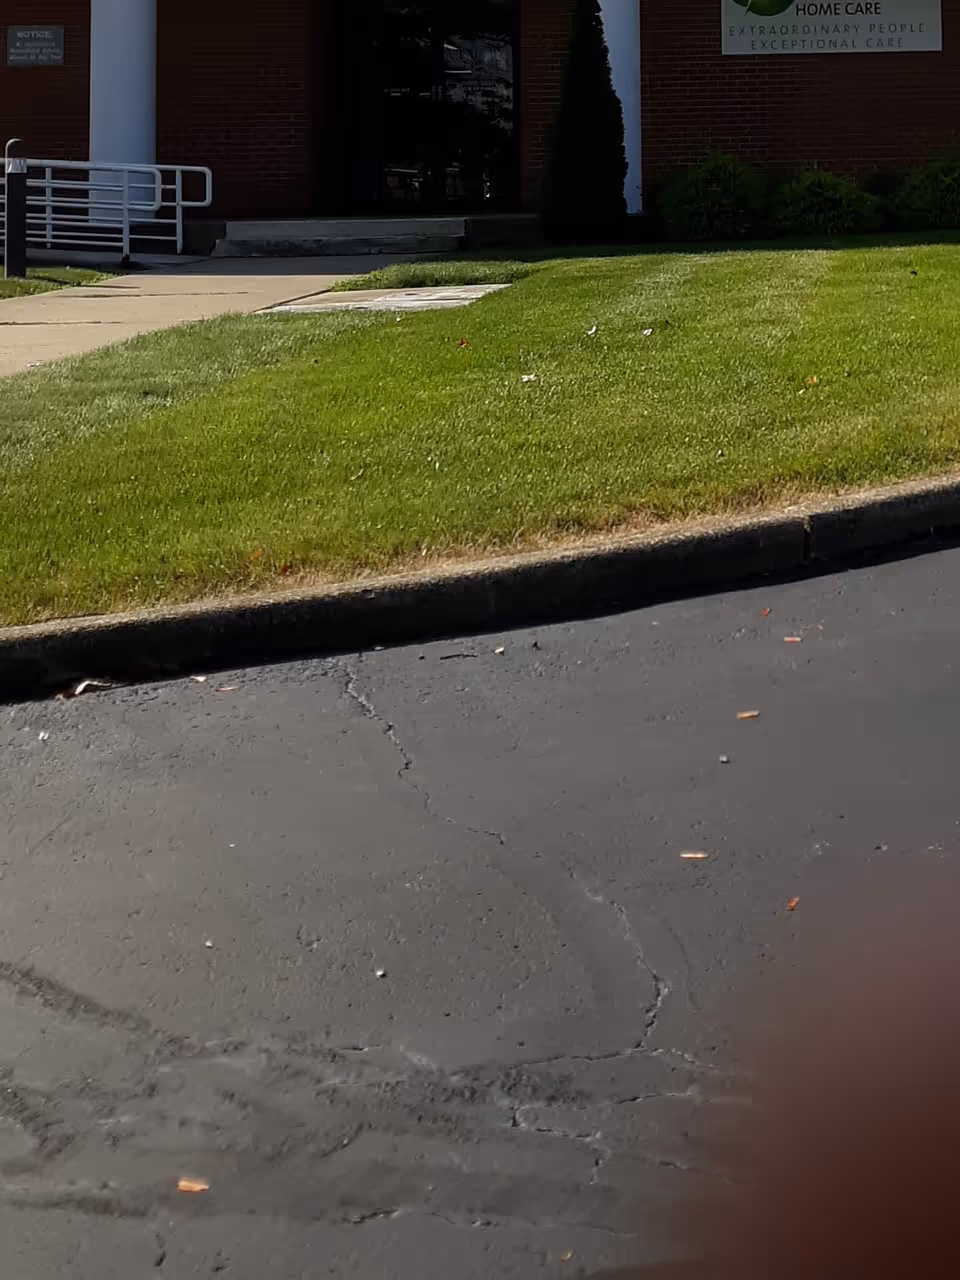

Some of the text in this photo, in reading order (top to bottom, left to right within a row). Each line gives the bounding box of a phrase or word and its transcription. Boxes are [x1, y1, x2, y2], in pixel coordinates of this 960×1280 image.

[795, 2, 882, 16] HOME CARE
[729, 24, 860, 37] EXTRAORDINARY
[751, 38, 857, 50] EXCEPTIONAL
